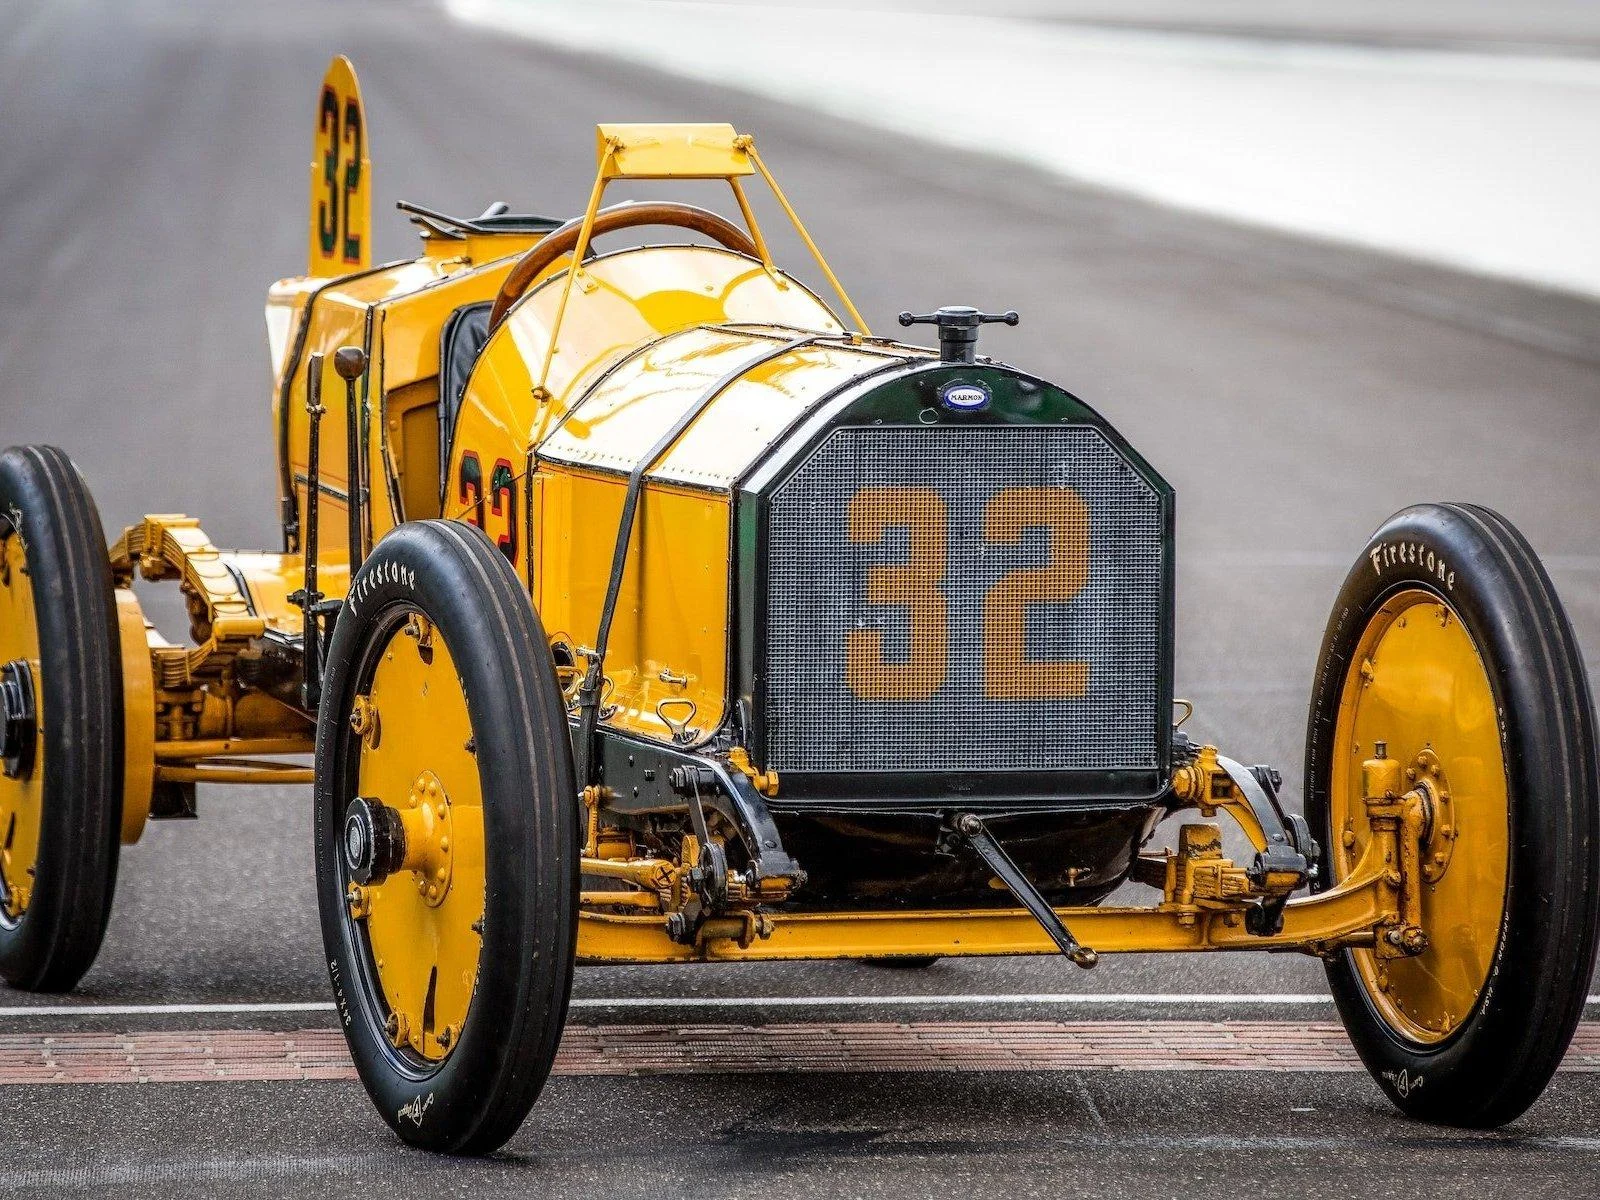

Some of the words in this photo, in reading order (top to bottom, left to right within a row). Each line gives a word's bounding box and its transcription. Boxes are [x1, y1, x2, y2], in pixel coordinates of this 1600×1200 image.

[320, 84, 361, 264] 32
[347, 558, 415, 617] Firestone
[848, 486, 1092, 700] 32
[1369, 542, 1455, 591] Firestone
